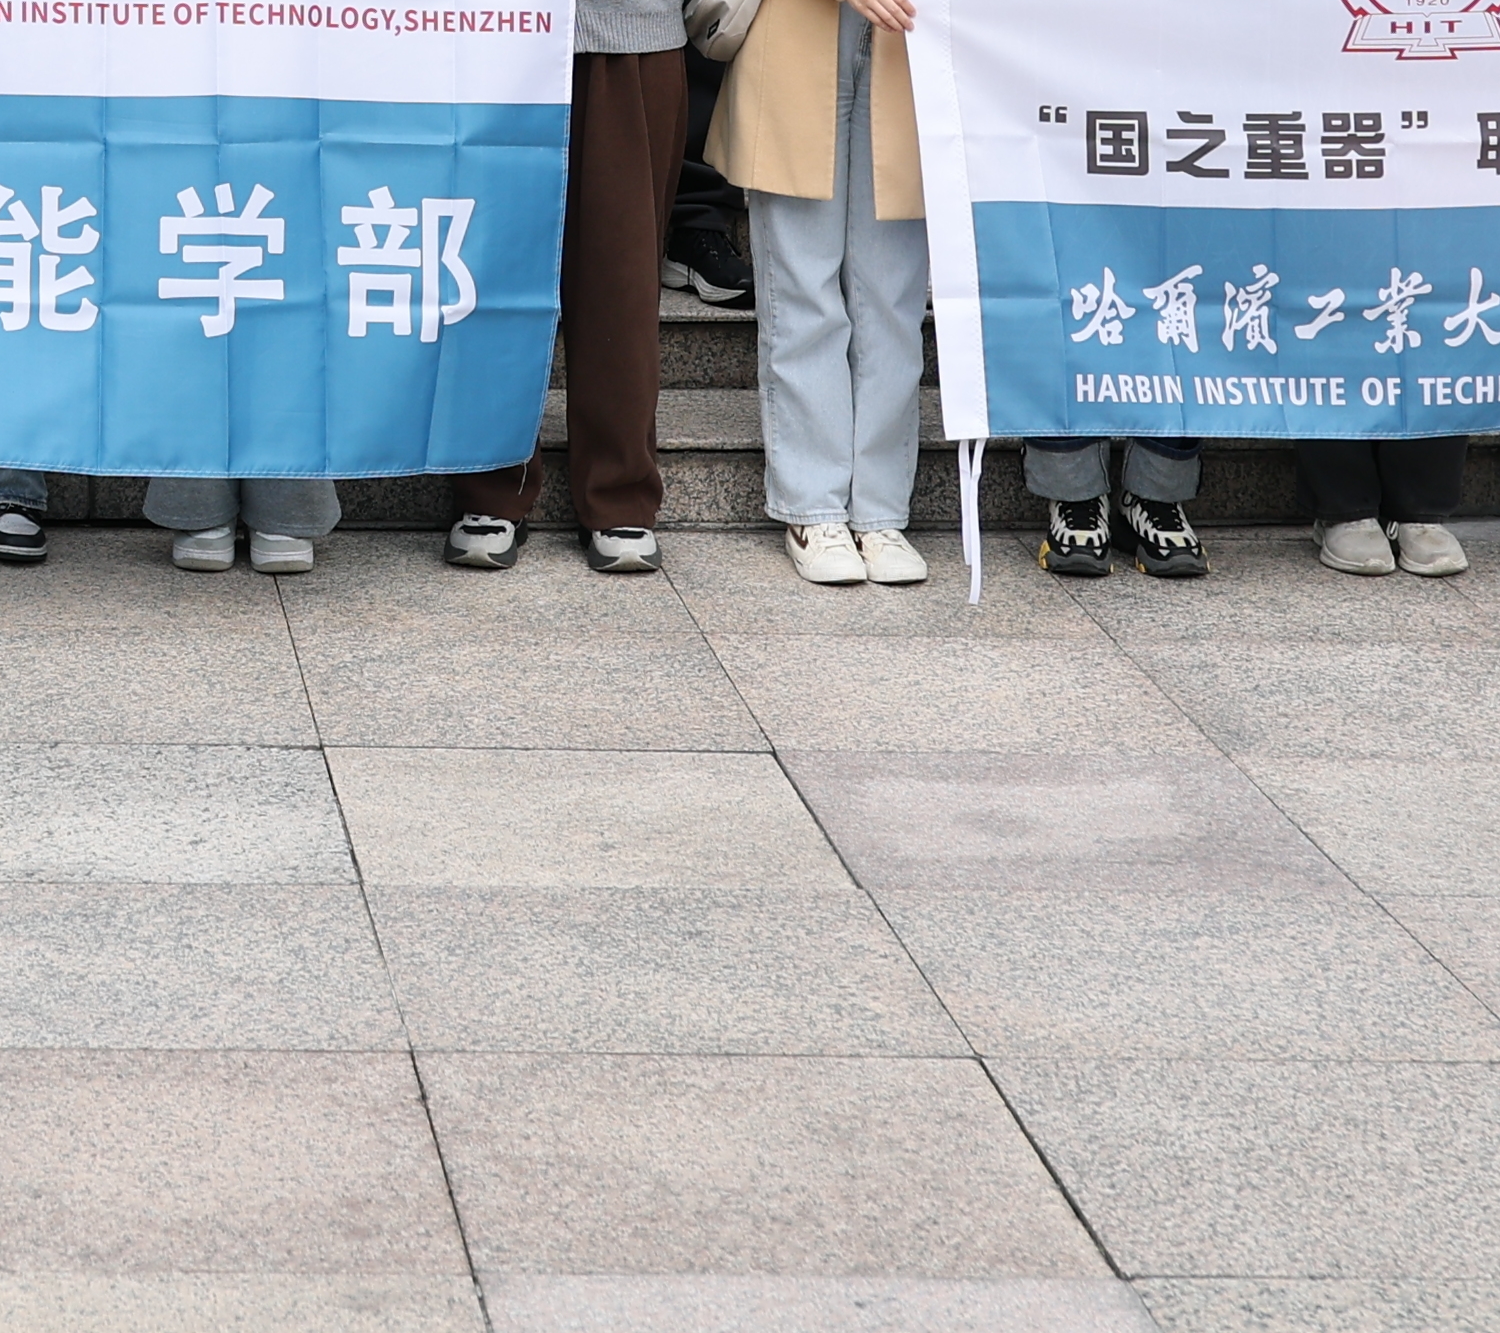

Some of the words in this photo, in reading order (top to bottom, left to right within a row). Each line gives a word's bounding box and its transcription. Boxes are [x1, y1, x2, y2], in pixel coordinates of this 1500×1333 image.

[21, 1, 167, 26] INSTITUTE
[173, 3, 211, 26] OF
[1390, 19, 1463, 35] HIT
[1076, 372, 1183, 404] HARBIN
[1194, 375, 1346, 407] INSTITUTE
[1361, 375, 1401, 407] OF
